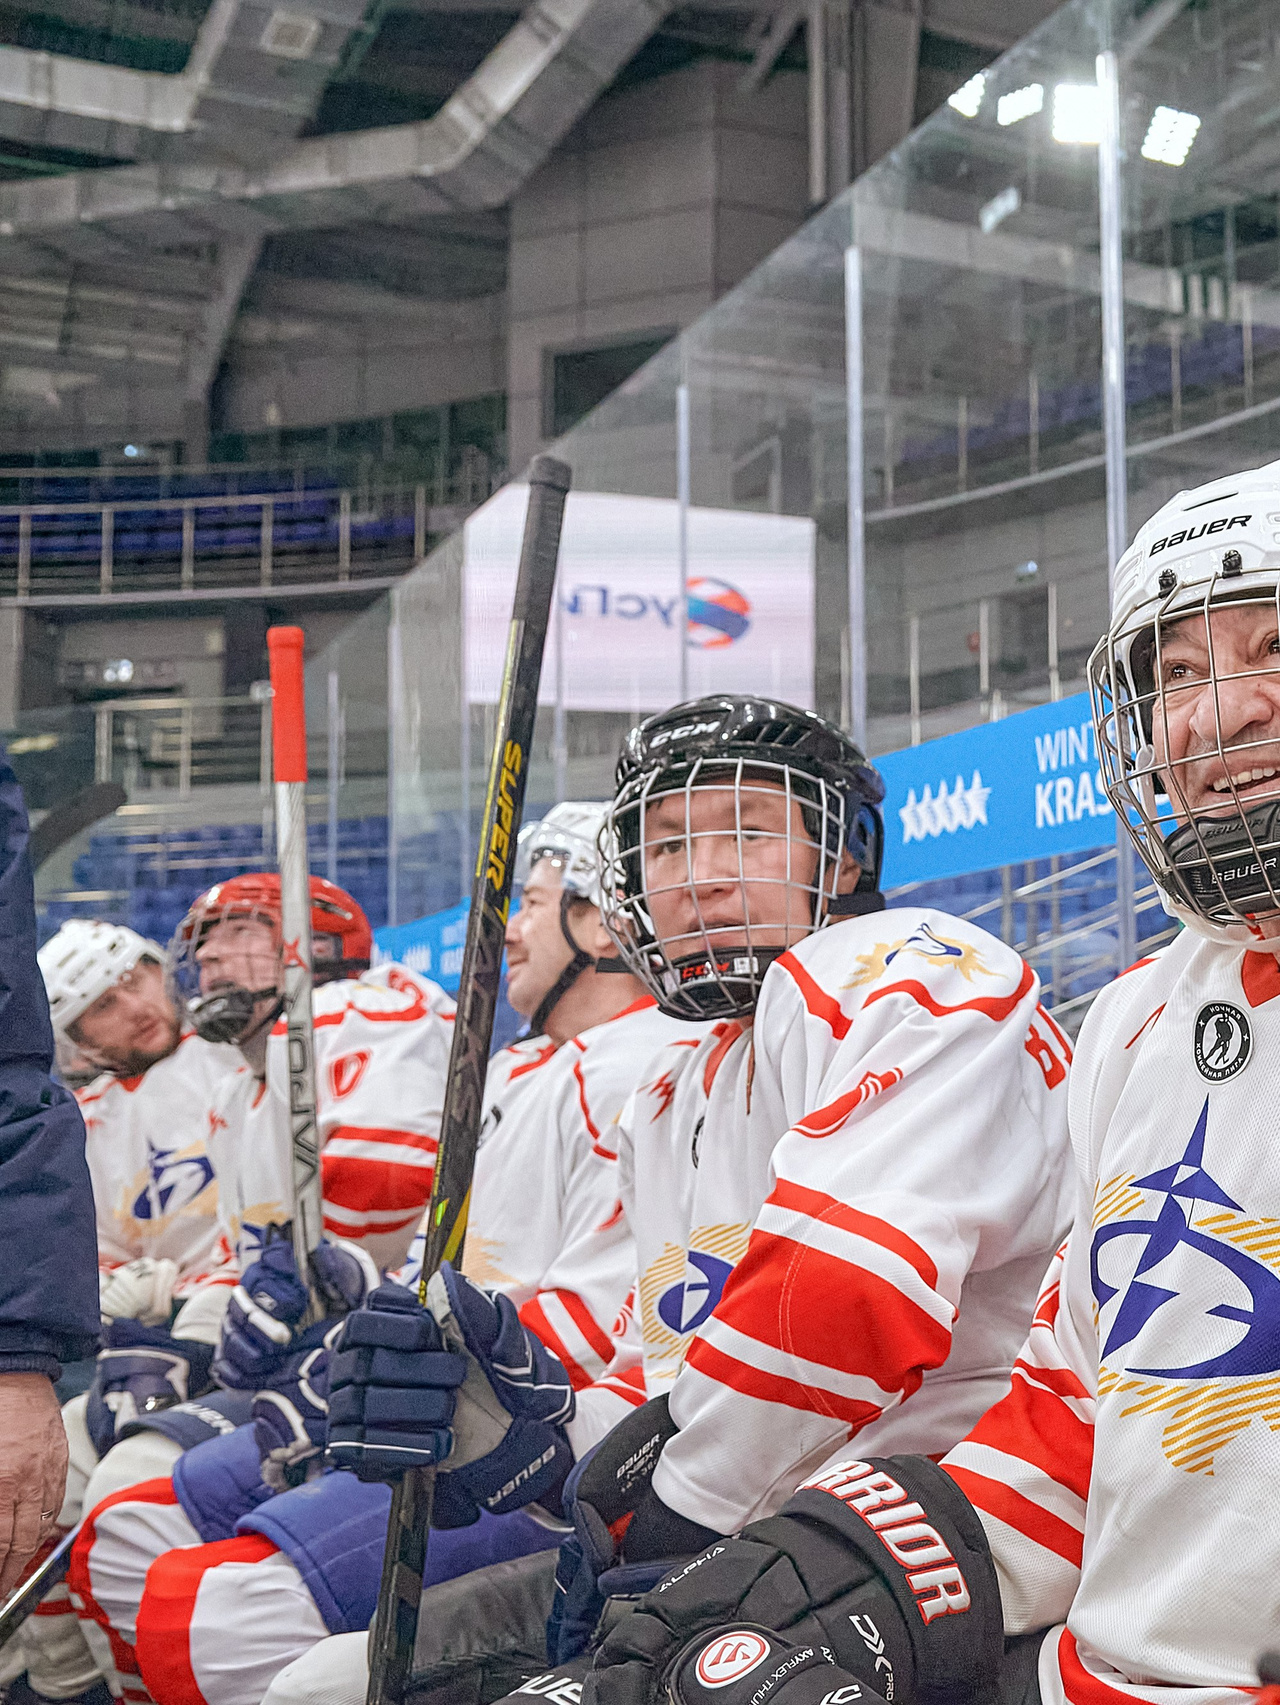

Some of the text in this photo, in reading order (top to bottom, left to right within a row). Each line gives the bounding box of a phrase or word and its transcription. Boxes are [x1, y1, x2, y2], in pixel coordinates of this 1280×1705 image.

[1148, 514, 1253, 558] BAUER
[650, 720, 721, 749] CCM
[486, 739, 522, 891] SUPER
[659, 1546, 726, 1592] ALPHA
